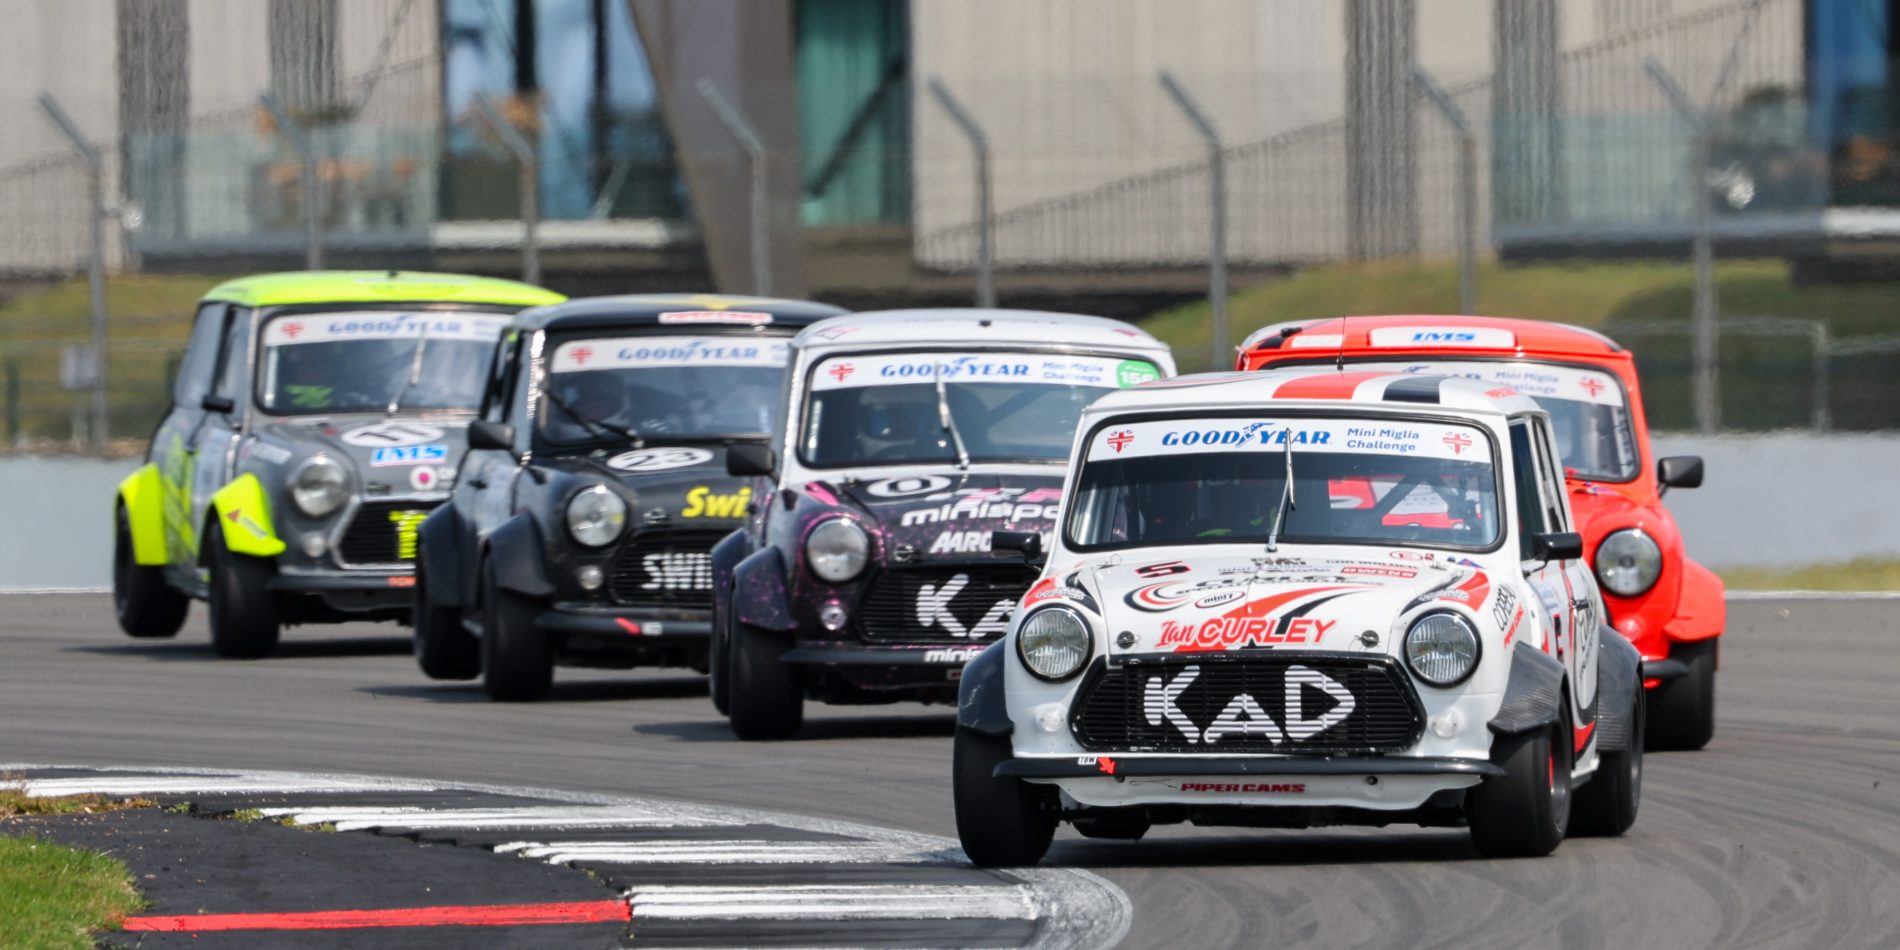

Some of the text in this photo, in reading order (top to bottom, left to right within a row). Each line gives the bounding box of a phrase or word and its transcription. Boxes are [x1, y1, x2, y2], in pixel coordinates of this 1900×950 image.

[328, 321, 461, 334] GOODYEAR
[1412, 332, 1476, 342] IMS
[618, 347, 758, 361] GOODYEAR
[881, 363, 1030, 377] GOODYEAR
[1494, 371, 1521, 381] Mini
[1523, 372, 1559, 385] Miglia
[1161, 429, 1331, 447] GOODYEAR
[1347, 427, 1420, 442] Mini Miglia
[1347, 439, 1416, 452] Challenge
[375, 446, 445, 460] IMS
[623, 449, 698, 468] 23
[682, 487, 751, 518] Swi
[1135, 560, 1191, 579] 5
[1156, 618, 1337, 647] Ian CURLEY
[1143, 664, 1356, 744] KAD
[1078, 756, 1097, 766] TOW
[1180, 782, 1306, 793] PIPER CAMS
